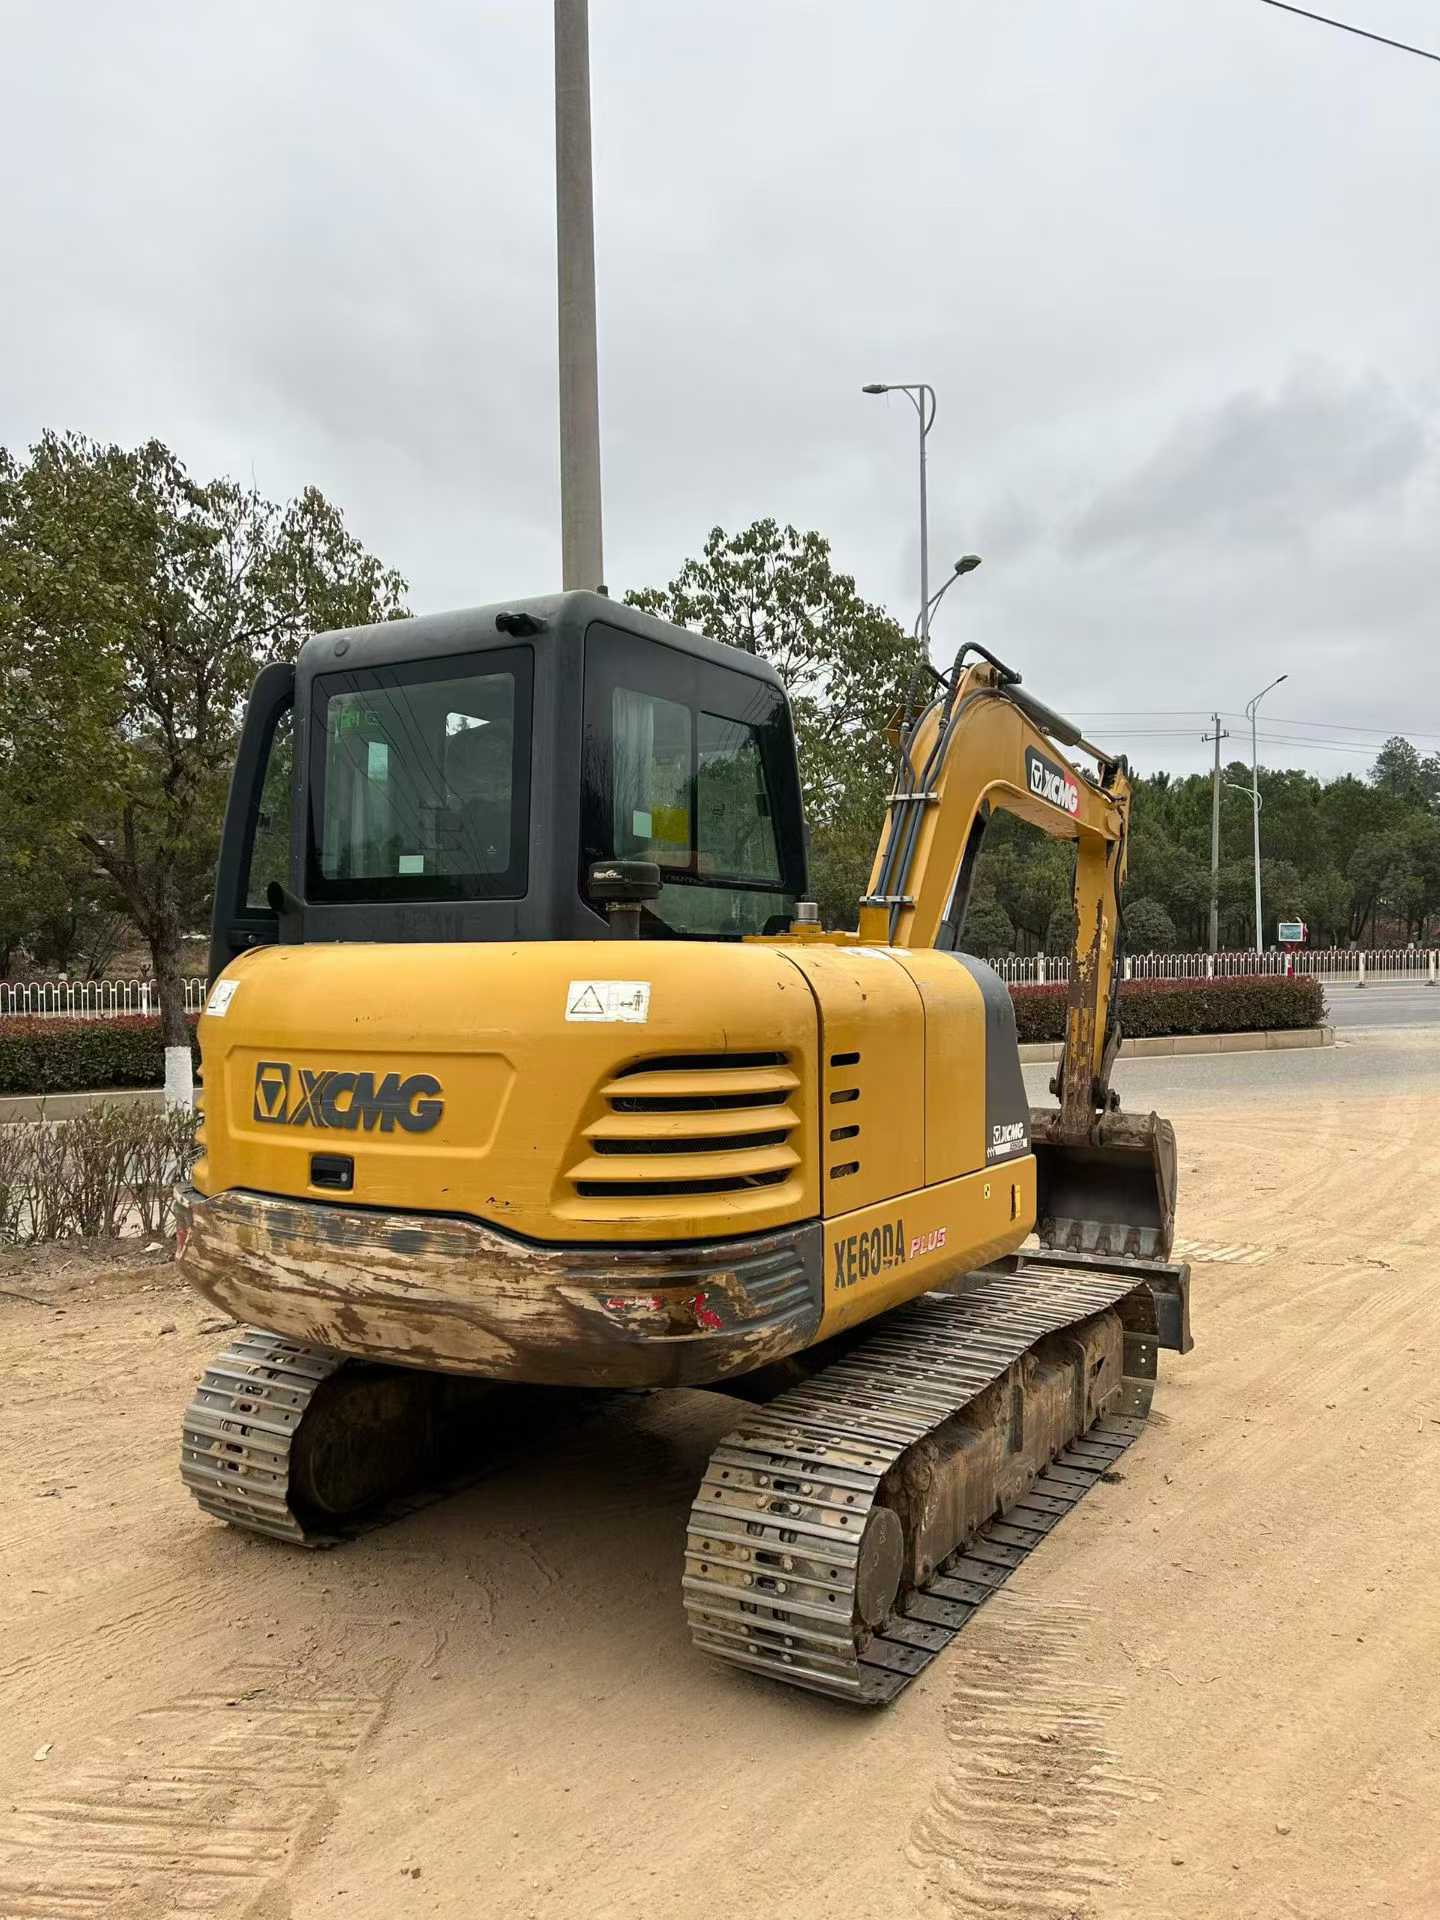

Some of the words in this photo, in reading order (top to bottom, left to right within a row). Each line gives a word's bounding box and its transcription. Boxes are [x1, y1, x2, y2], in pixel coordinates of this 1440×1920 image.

[1042, 769, 1078, 813] XCMG
[287, 1069, 444, 1132] XCMG
[1001, 1122, 1024, 1144] XCMG
[834, 1218, 906, 1289] XE60DA
[910, 1227, 947, 1259] PLUS
